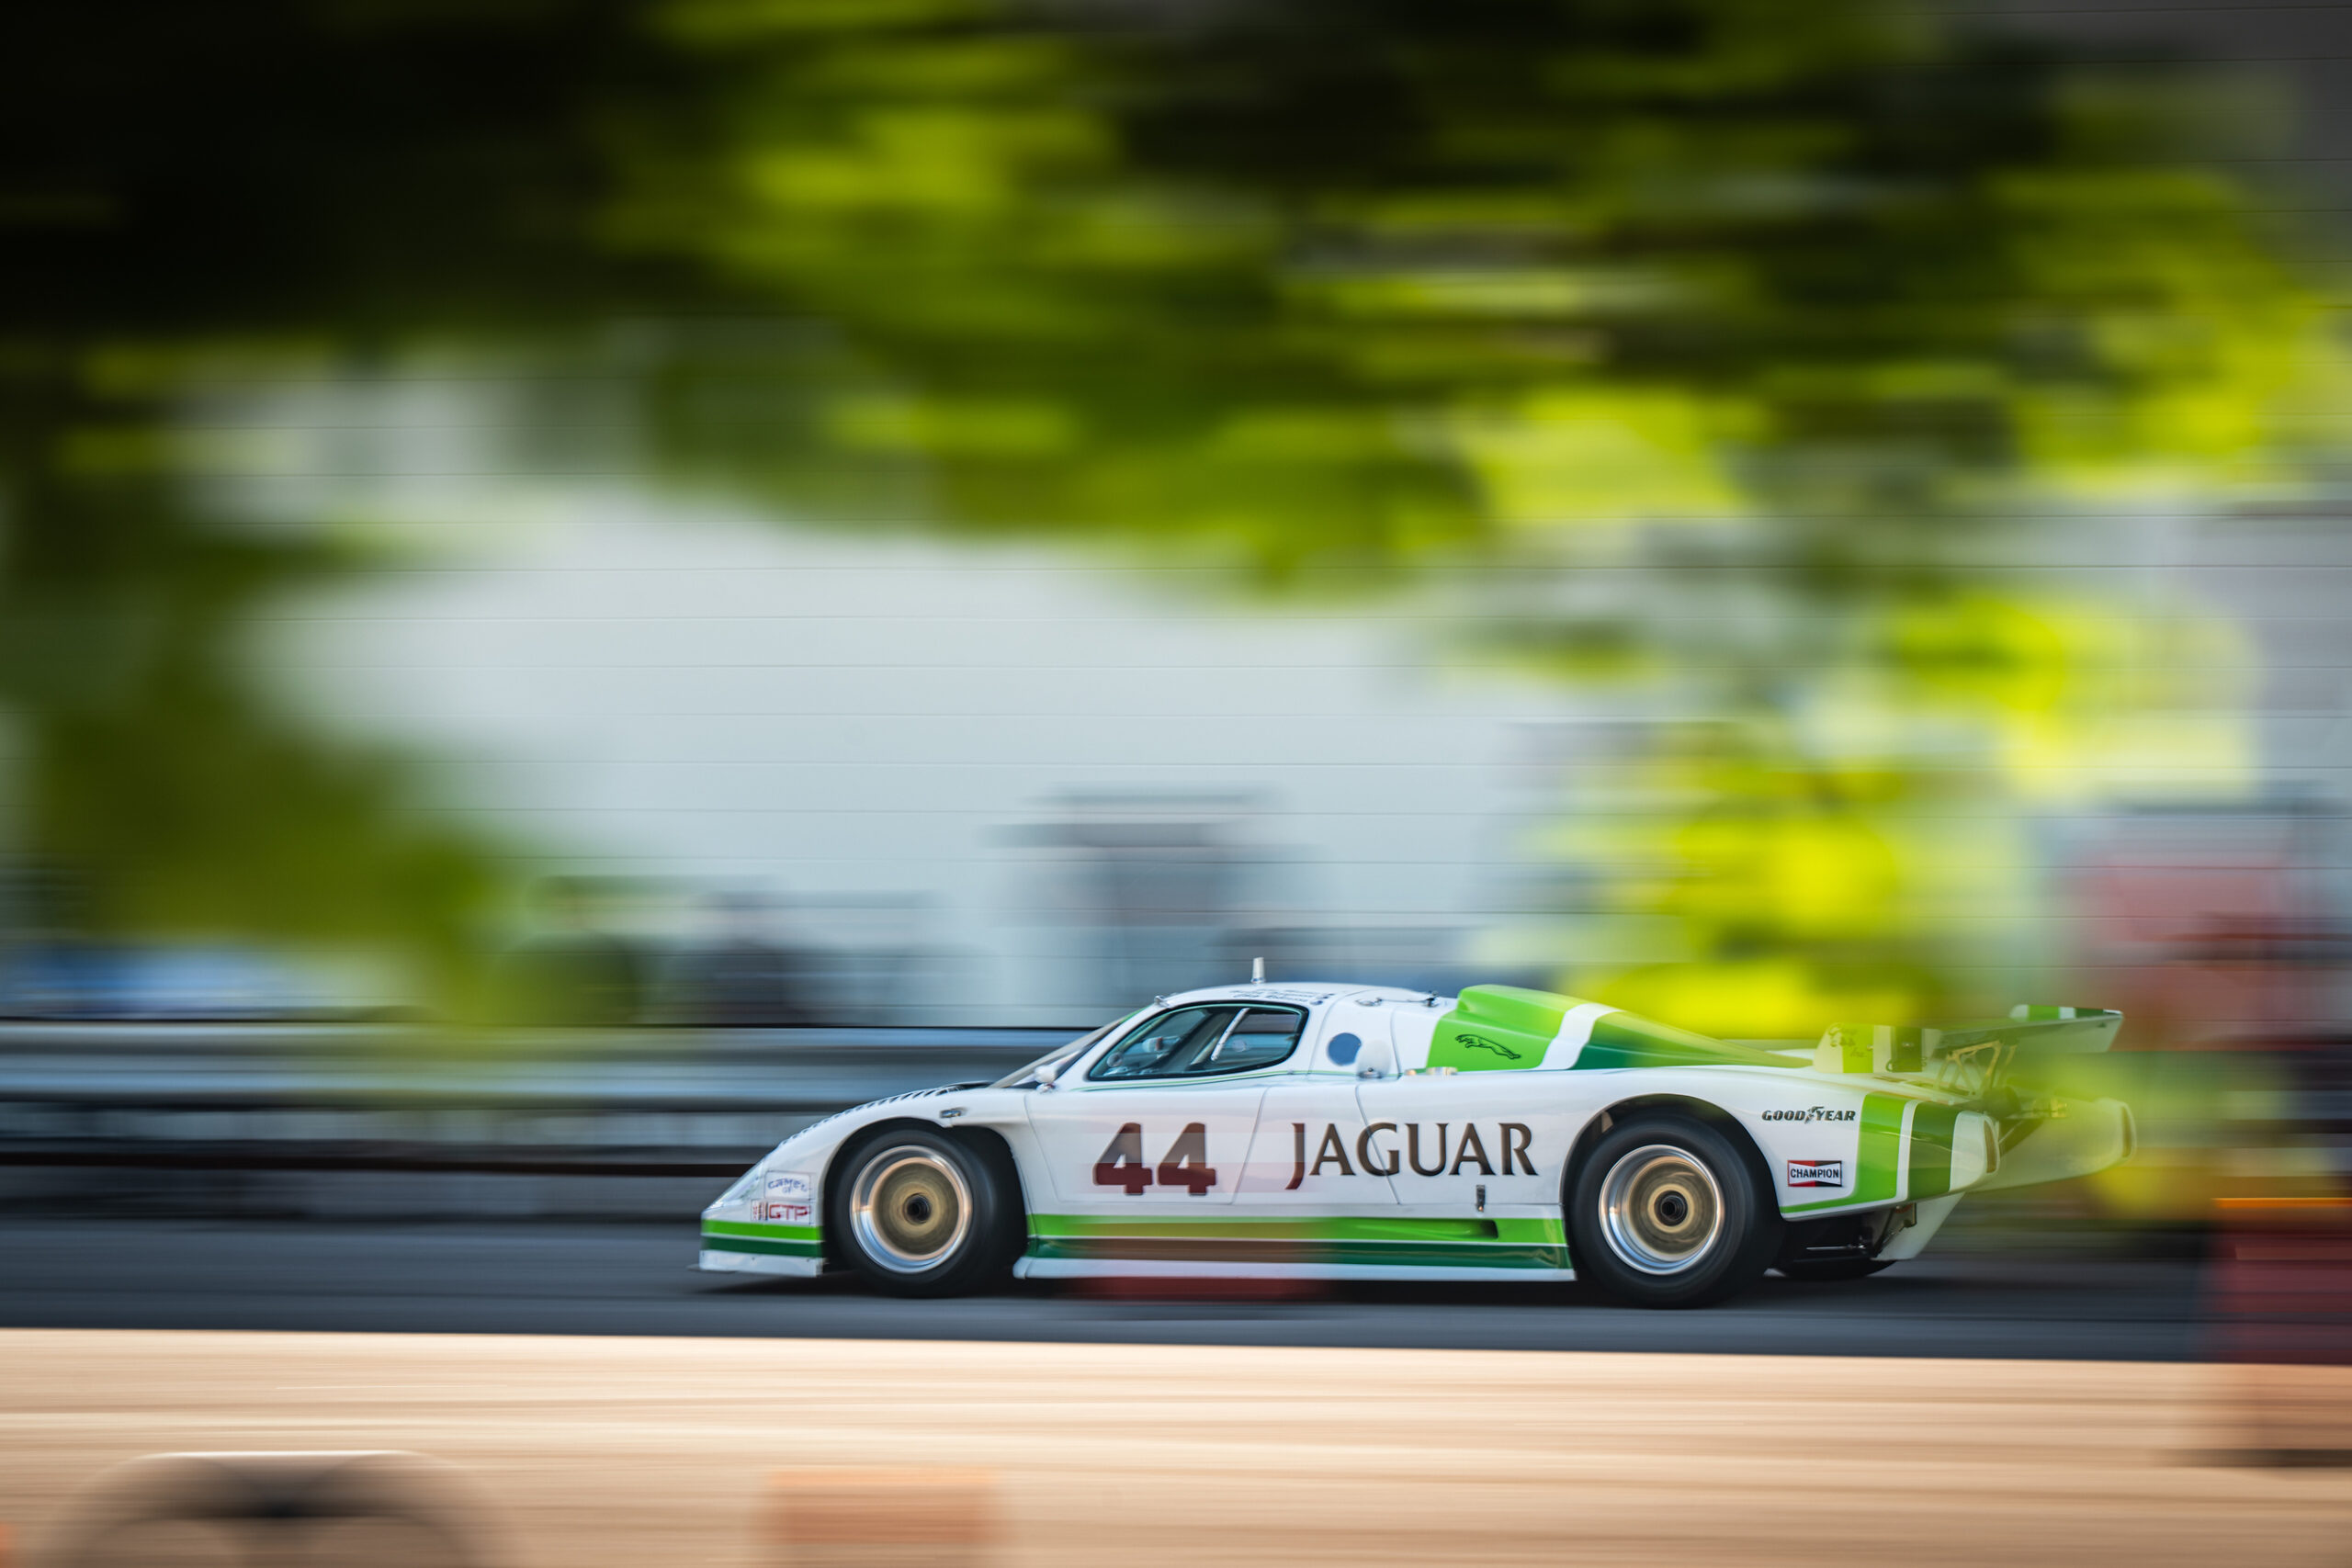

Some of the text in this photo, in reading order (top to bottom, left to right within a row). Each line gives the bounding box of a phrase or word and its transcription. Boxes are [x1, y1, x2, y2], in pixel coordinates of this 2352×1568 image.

[1092, 1122, 1216, 1195] 44
[1285, 1122, 1539, 1190] JAGUAR
[1790, 1168, 1839, 1179] CHAMPION
[769, 1204, 808, 1221] GTP
